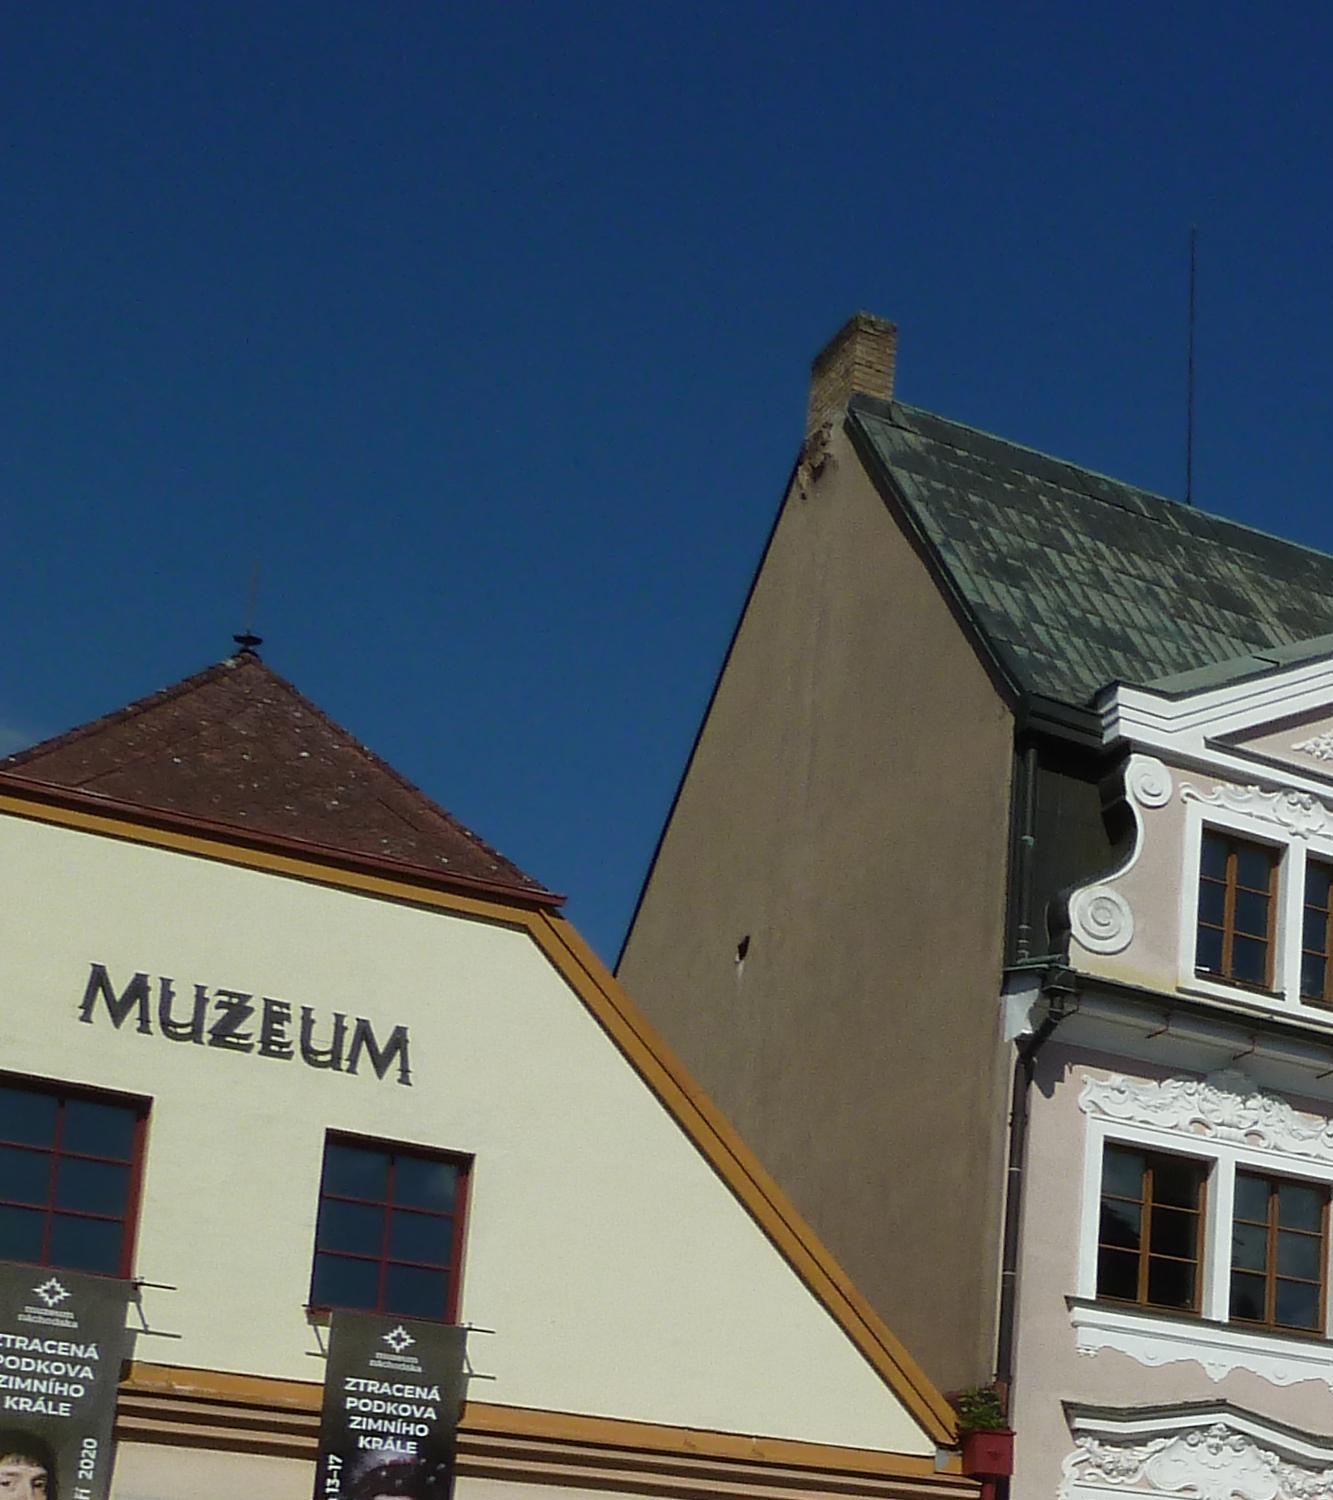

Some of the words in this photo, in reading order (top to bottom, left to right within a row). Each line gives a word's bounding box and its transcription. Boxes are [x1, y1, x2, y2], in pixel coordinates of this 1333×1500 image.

[79, 962, 412, 1086] MUZEUM
[0, 1374, 85, 1397] ZIMNÍHO
[344, 1377, 441, 1402] ZTRACENÁ
[4, 1395, 73, 1417] KRÁLE
[346, 1397, 437, 1421] PODKOVA
[349, 1416, 430, 1437] ZIMNÍHO
[358, 1435, 418, 1455] KRÁLE
[78, 1438, 98, 1480] 2020
